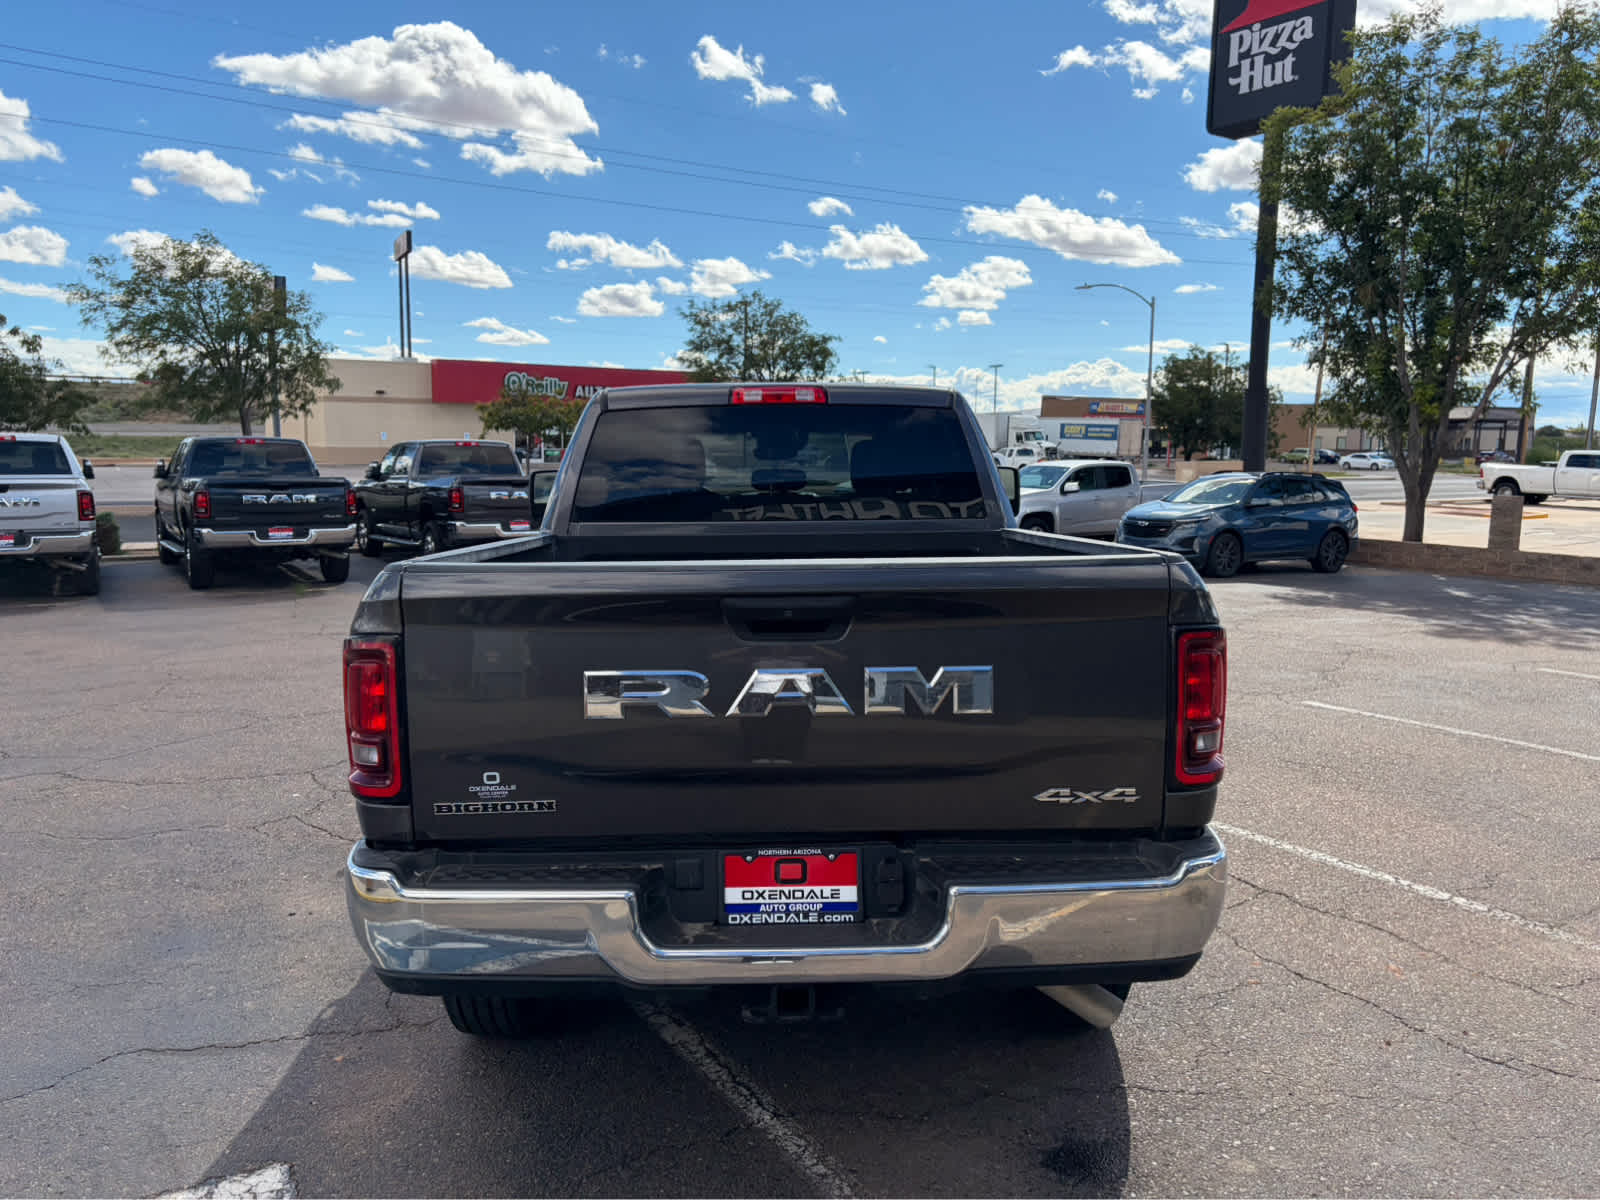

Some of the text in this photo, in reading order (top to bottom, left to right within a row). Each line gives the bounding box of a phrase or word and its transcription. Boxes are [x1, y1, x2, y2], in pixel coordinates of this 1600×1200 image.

[1227, 16, 1314, 68] Pizza
[1228, 53, 1296, 95] Hut
[504, 371, 568, 399] O'Reilly
[242, 494, 317, 504] RAM
[584, 666, 993, 719] RAM
[1033, 787, 1141, 803] 4x4
[433, 800, 556, 815] BIGHORN
[742, 889, 840, 900] OXENDALE
[760, 903, 823, 912] AUTO GROUP
[728, 912, 854, 924] OXENDALE.com
